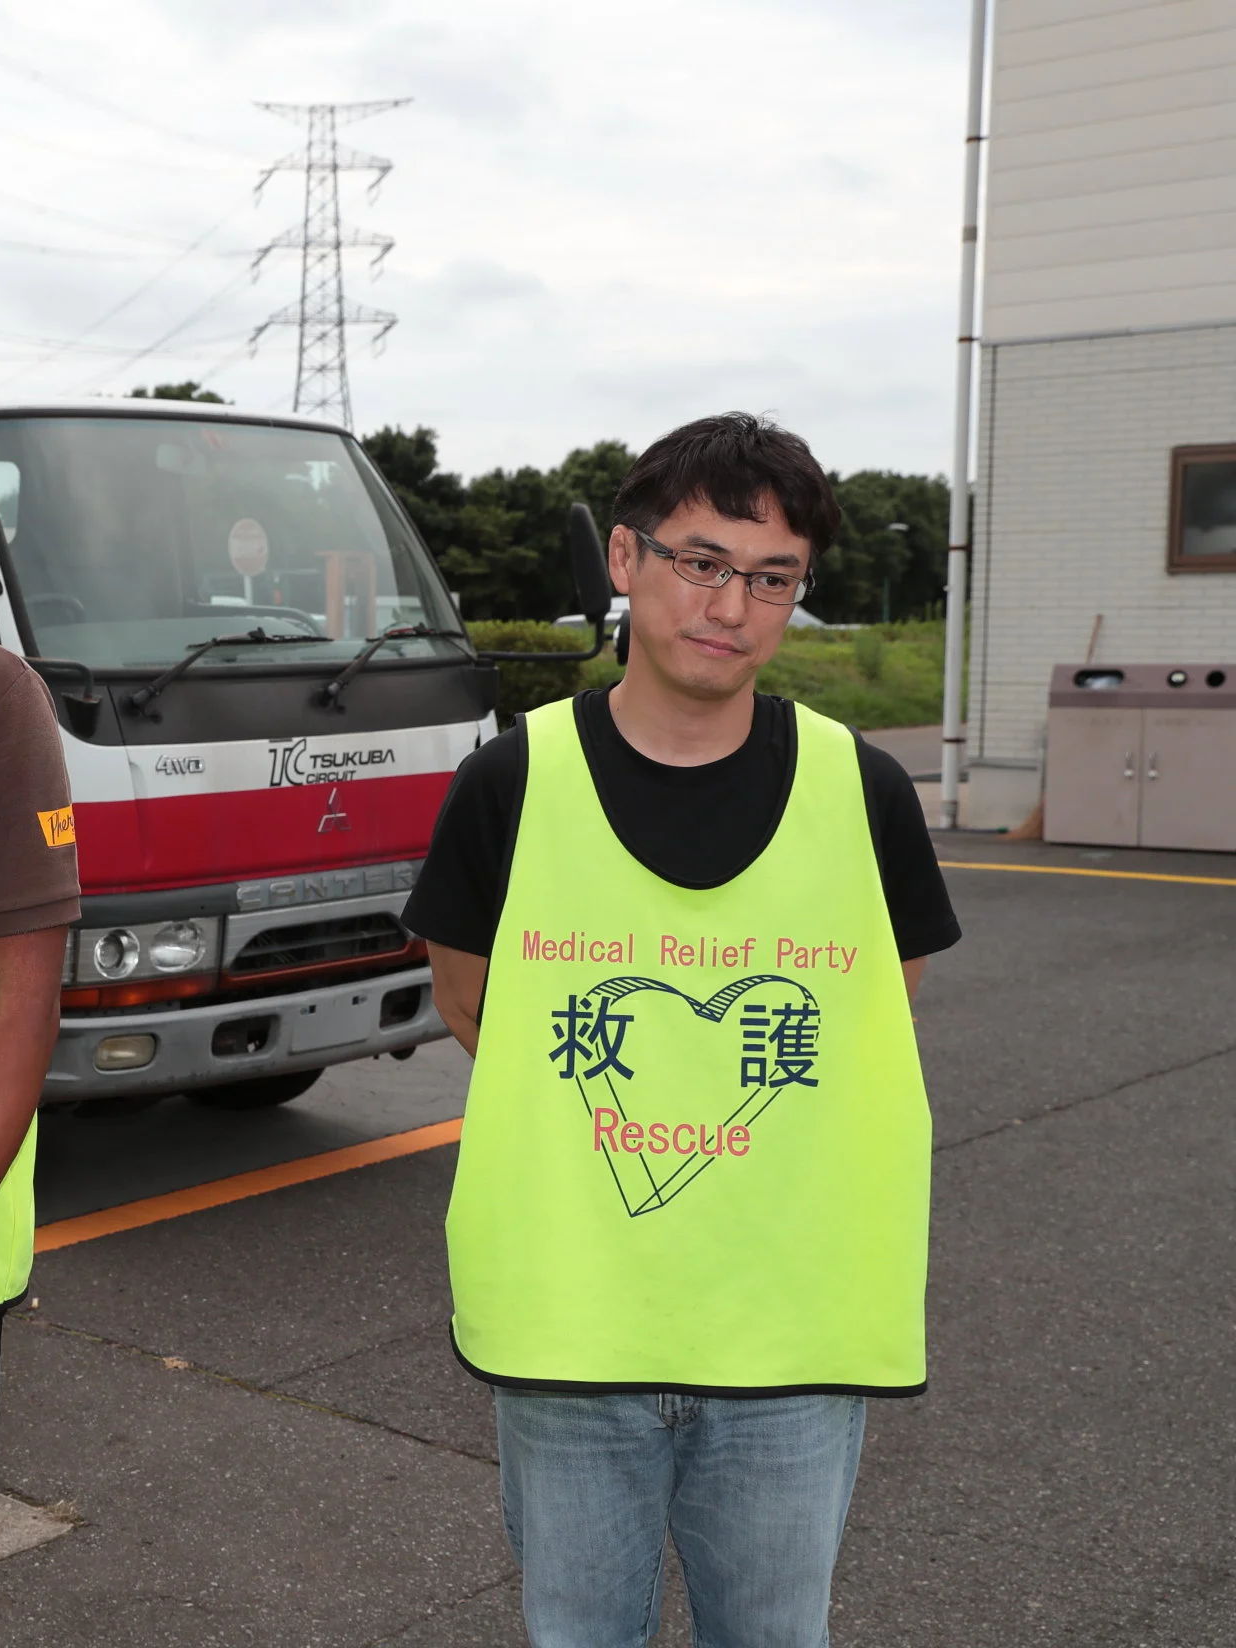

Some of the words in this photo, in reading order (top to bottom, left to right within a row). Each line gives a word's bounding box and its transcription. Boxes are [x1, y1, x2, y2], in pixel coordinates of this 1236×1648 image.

[155, 755, 205, 776] 4WD
[268, 738, 307, 787] TC
[309, 749, 396, 769] TSUKUBA
[305, 770, 357, 785] CIRCUIT
[522, 930, 634, 964] Medical
[660, 935, 757, 968] Relief
[776, 938, 858, 974] Party
[593, 1107, 751, 1156] Rescue
